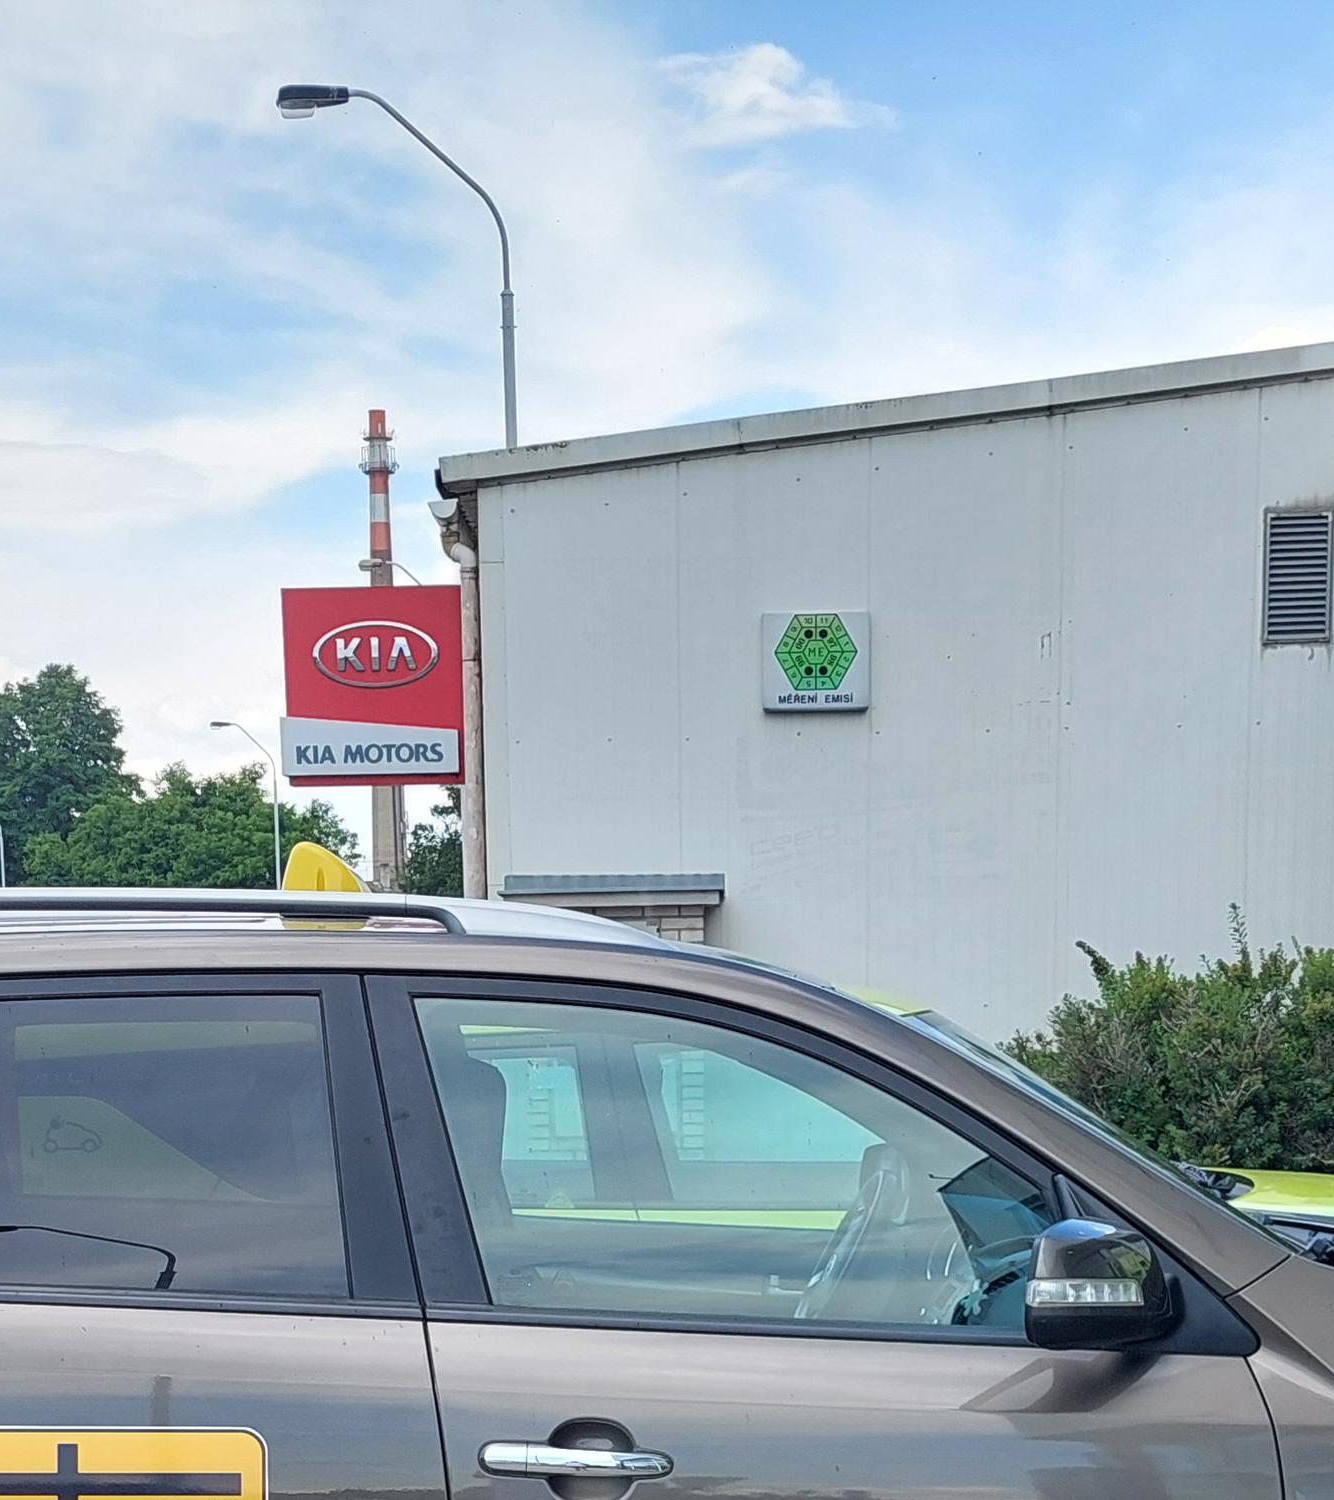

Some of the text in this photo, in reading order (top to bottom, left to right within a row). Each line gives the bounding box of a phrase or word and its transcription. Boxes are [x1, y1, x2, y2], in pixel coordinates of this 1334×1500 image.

[334, 637, 417, 673] KIA
[808, 647, 825, 657] ME
[778, 692, 854, 704] MĚŘENÍ EMISÍ
[296, 743, 444, 765] KIA MOTORS
